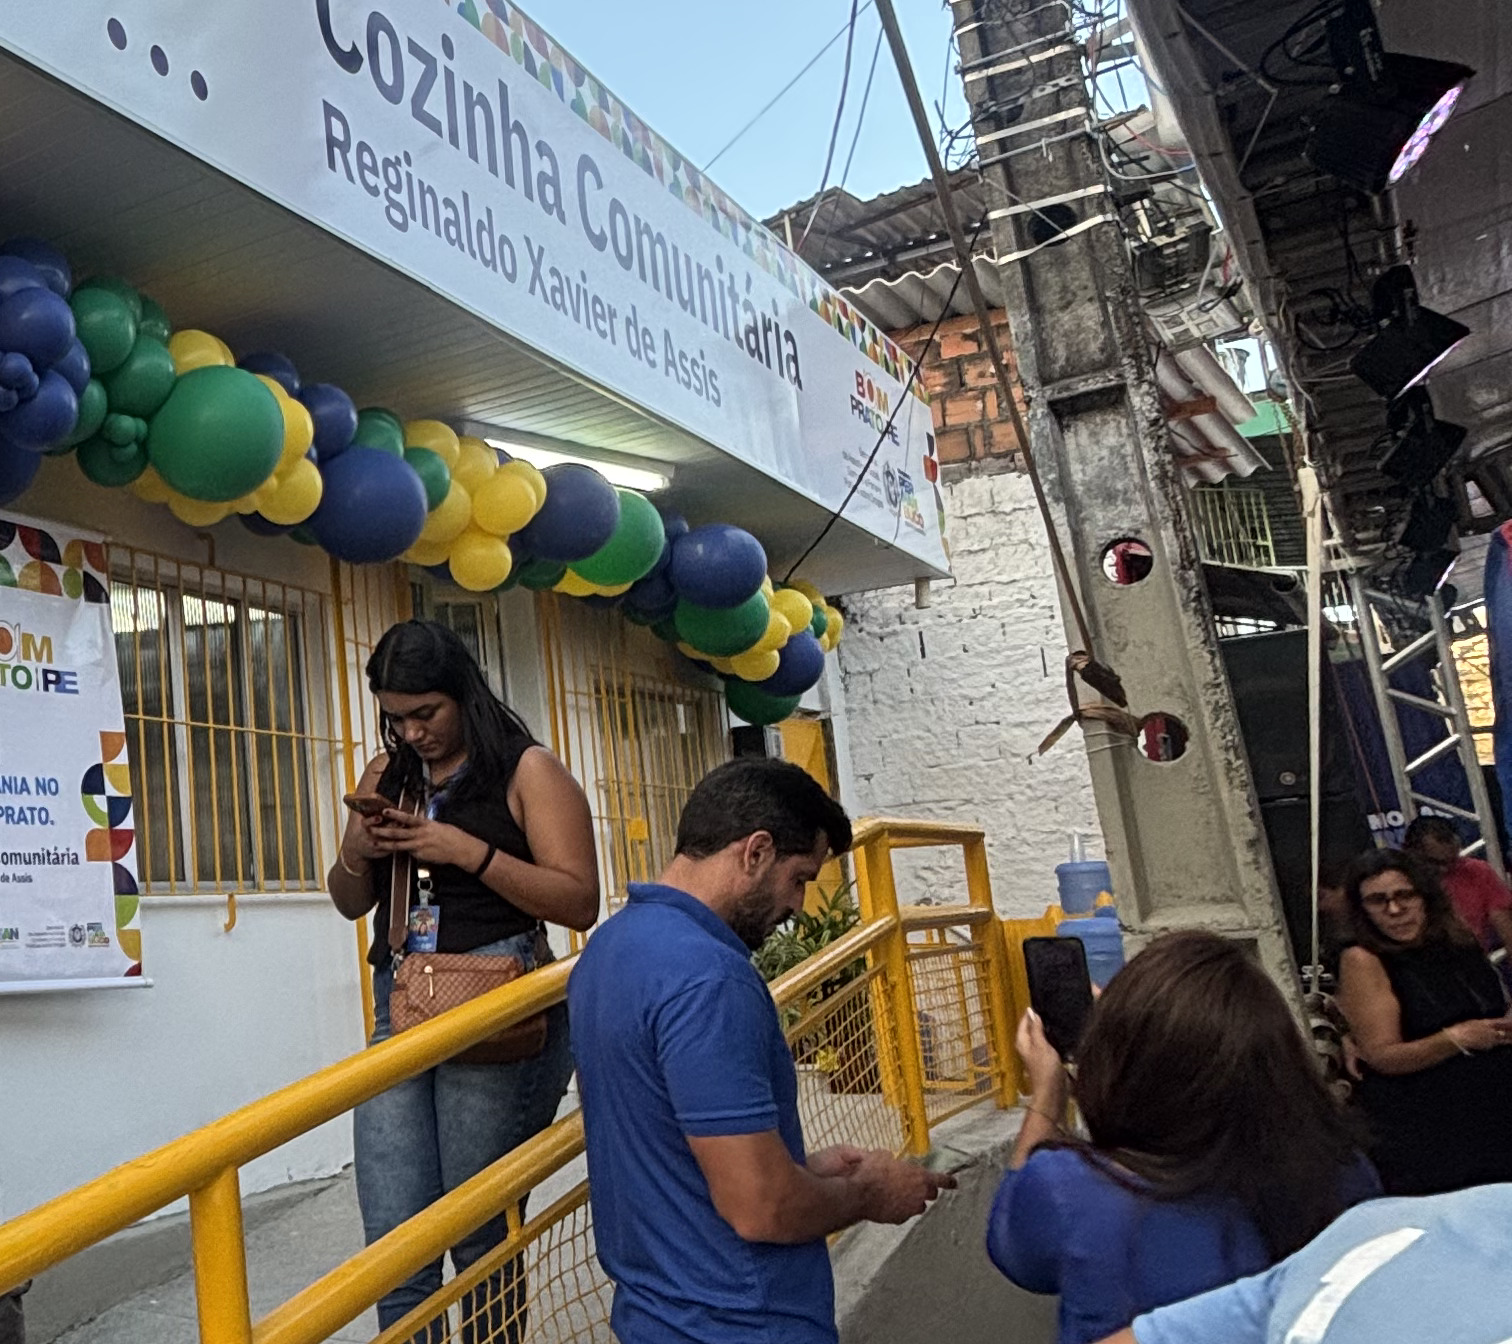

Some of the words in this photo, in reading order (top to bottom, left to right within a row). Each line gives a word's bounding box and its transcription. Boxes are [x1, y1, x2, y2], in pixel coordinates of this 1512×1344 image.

[322, 100, 518, 286] Reginaldo
[525, 235, 618, 341] Xavier
[626, 302, 657, 365] de
[664, 328, 723, 410] Assis
[577, 152, 804, 391] Comunitária
[854, 369, 889, 417] BOM
[35, 776, 59, 796] NO
[0, 872, 10, 883] de
[12, 872, 33, 884] Assis
